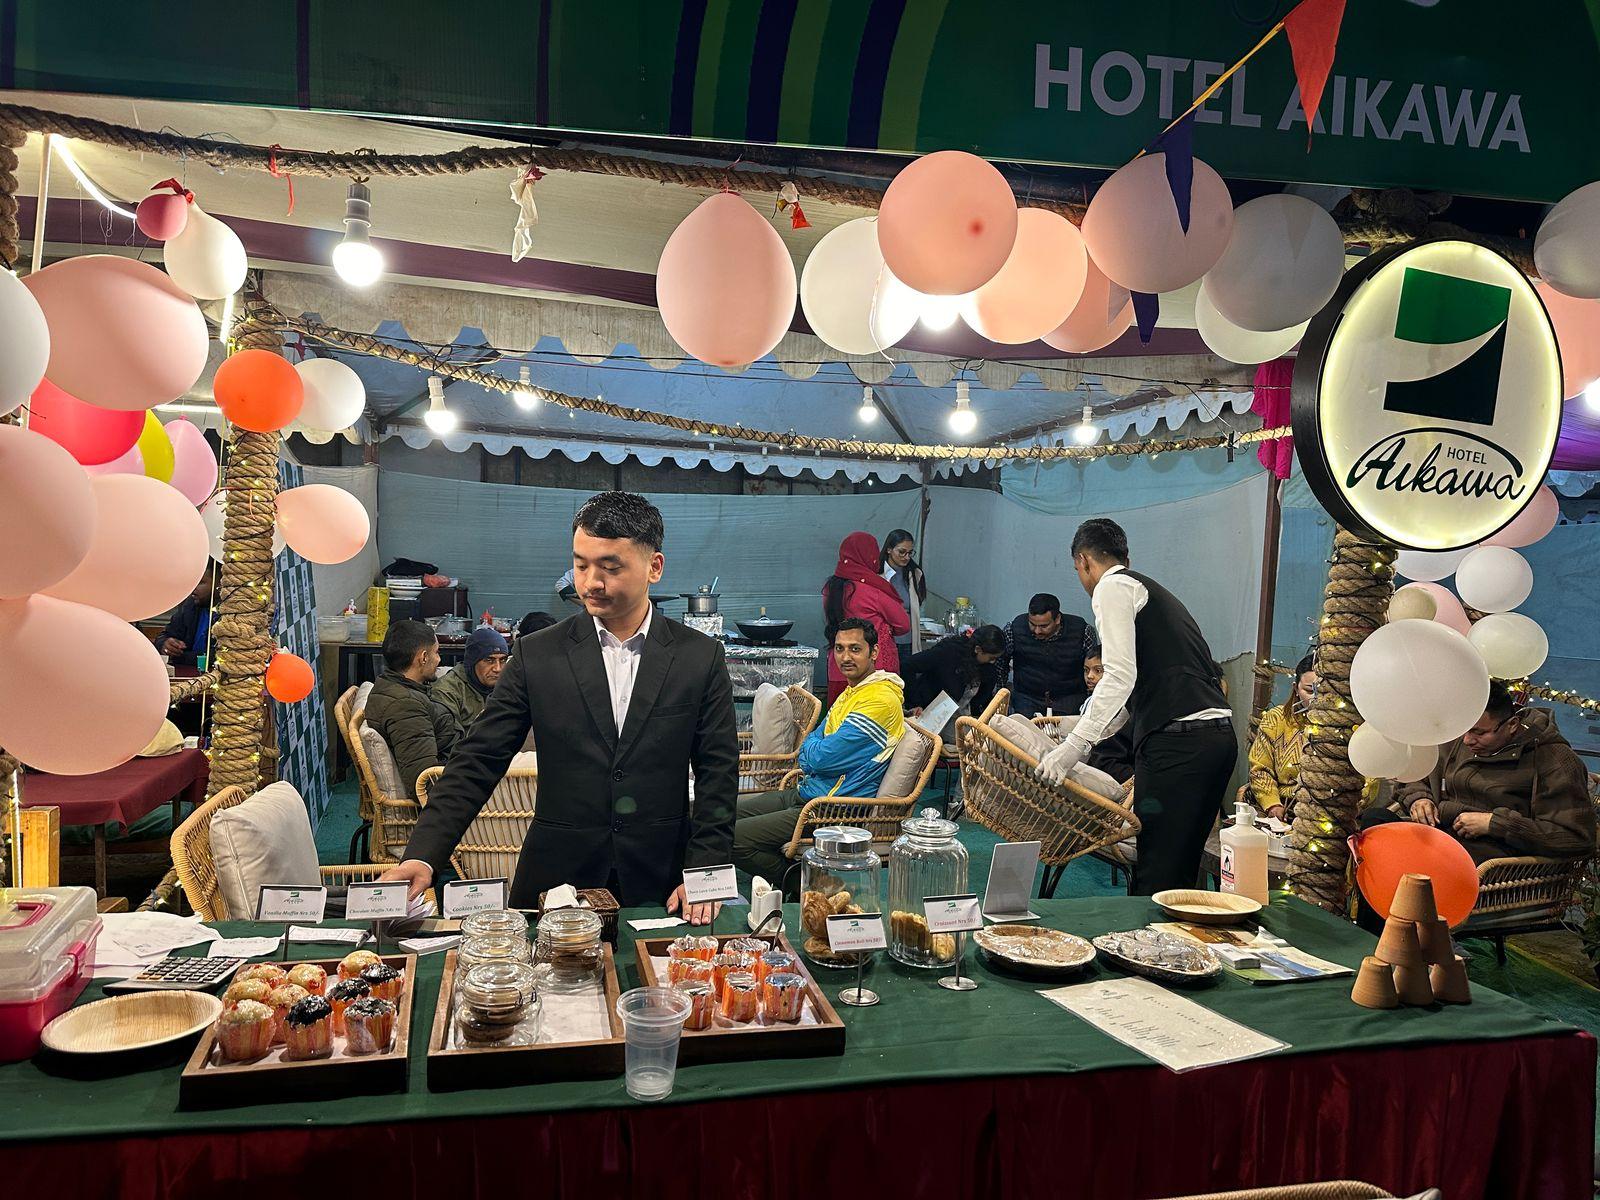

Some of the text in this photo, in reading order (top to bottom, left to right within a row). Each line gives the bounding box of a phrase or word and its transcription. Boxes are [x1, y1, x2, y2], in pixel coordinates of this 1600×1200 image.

[1034, 43, 1532, 154] HOTEL AIKAWA
[1446, 446, 1488, 465] HOTEL
[1347, 437, 1526, 501] Aikawa
[282, 909, 299, 917] Muffin
[452, 904, 473, 912] Cookies
